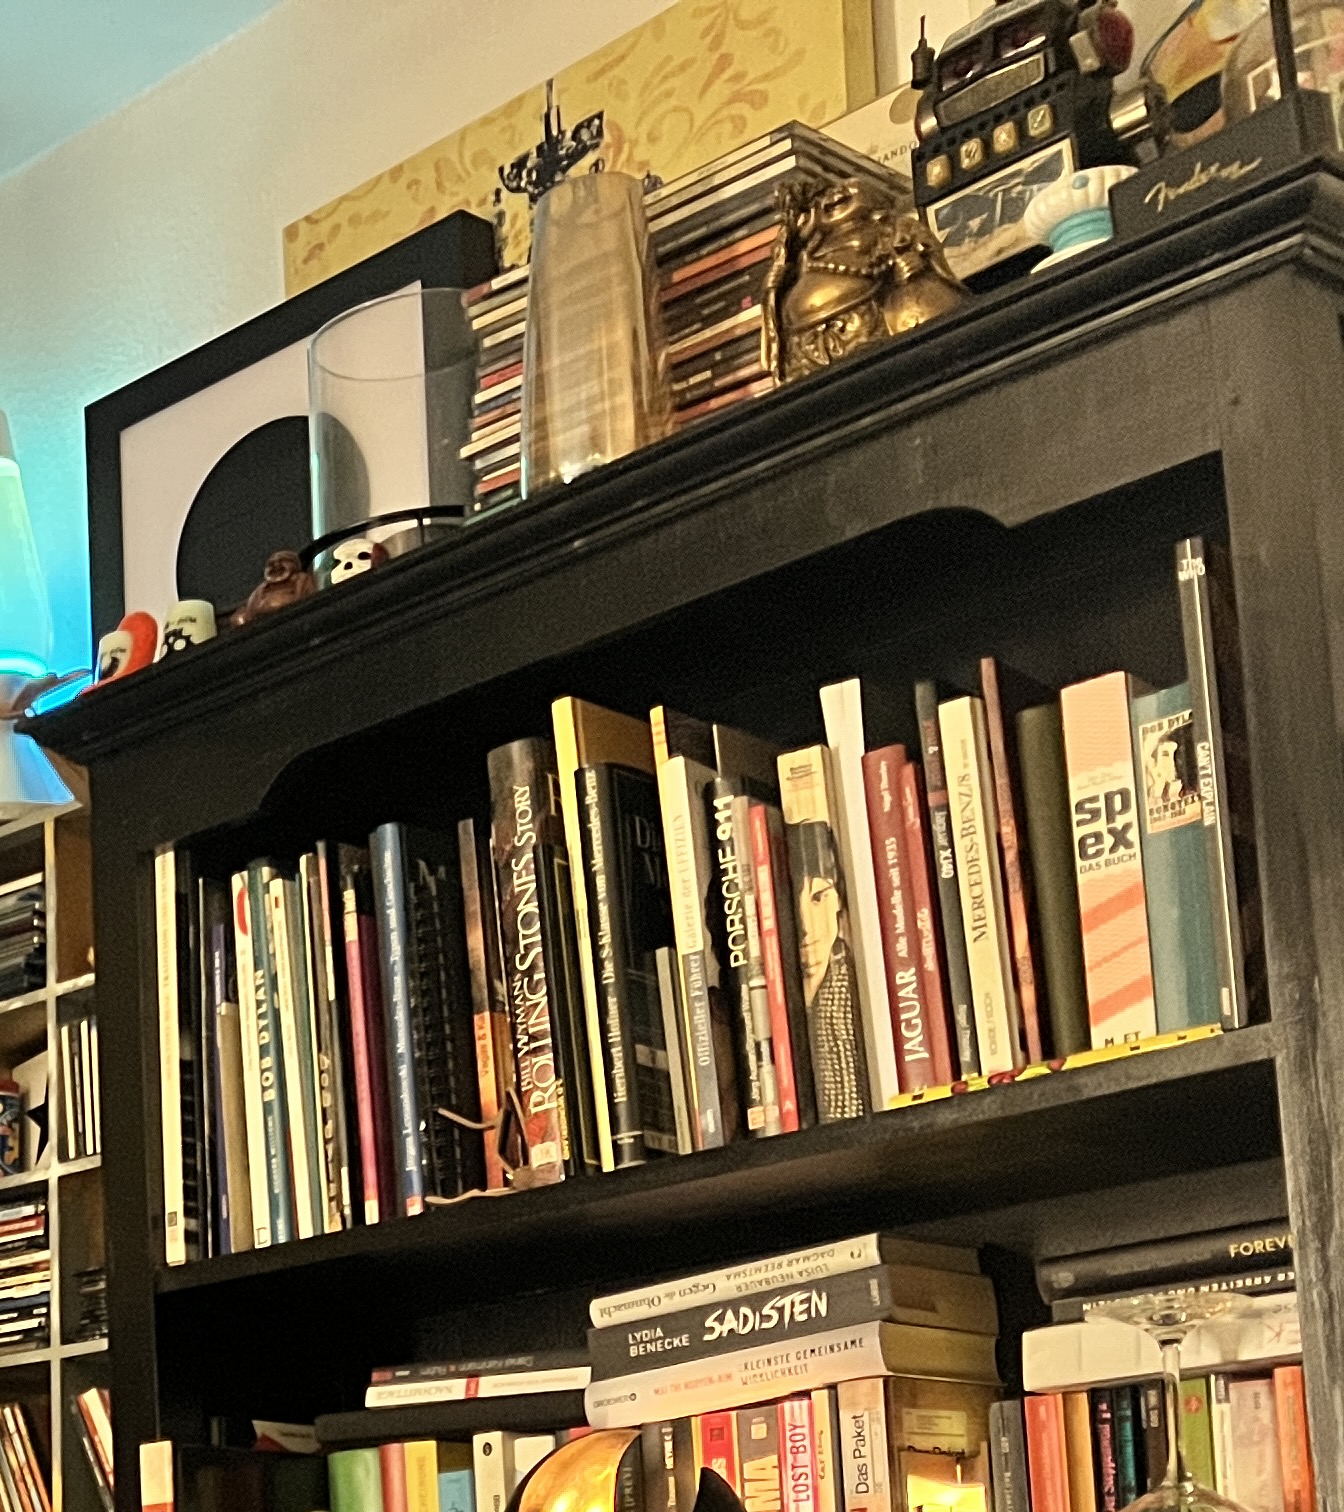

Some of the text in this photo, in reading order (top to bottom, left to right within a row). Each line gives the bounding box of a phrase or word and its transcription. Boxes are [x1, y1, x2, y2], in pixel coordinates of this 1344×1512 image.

[1141, 722, 1164, 737] BOB
[582, 771, 606, 873] Mercedes-Benz
[1075, 787, 1132, 828] sp
[957, 772, 990, 944] MERCEDES-BENZ/8
[1078, 821, 1135, 862] ex
[888, 866, 901, 887] seit
[937, 847, 955, 879] XJ40
[1079, 852, 1137, 875] DAS BUCH
[594, 873, 607, 899] von
[678, 877, 693, 898] der
[713, 795, 749, 967] PORSCHE 911
[890, 888, 907, 934] Modelle
[595, 901, 615, 959] S-Klasse
[894, 935, 909, 958] Alle
[511, 783, 558, 1115] ROLLING STONES STORY
[601, 959, 617, 985] Die
[686, 952, 712, 1067] Offizieller Führer
[895, 967, 931, 1063] JAGUAR
[253, 968, 276, 1102] BOB DYLAN
[518, 1058, 534, 1092] BILL
[724, 1248, 836, 1283] DAGMAR REEMTSMA
[734, 1262, 830, 1294] LUISA NEUBAUER
[597, 1294, 663, 1319] Ohnmacht
[678, 1281, 717, 1300] Gegen
[628, 1327, 664, 1345] LYDIA
[629, 1334, 690, 1358] BENECKE
[744, 1336, 865, 1373] KLEINSTE GEMEINSAME
[740, 1364, 809, 1386] WIRKLICHKEIT
[787, 1422, 811, 1505] LOST BOY
[851, 1411, 870, 1496] Das Paket
